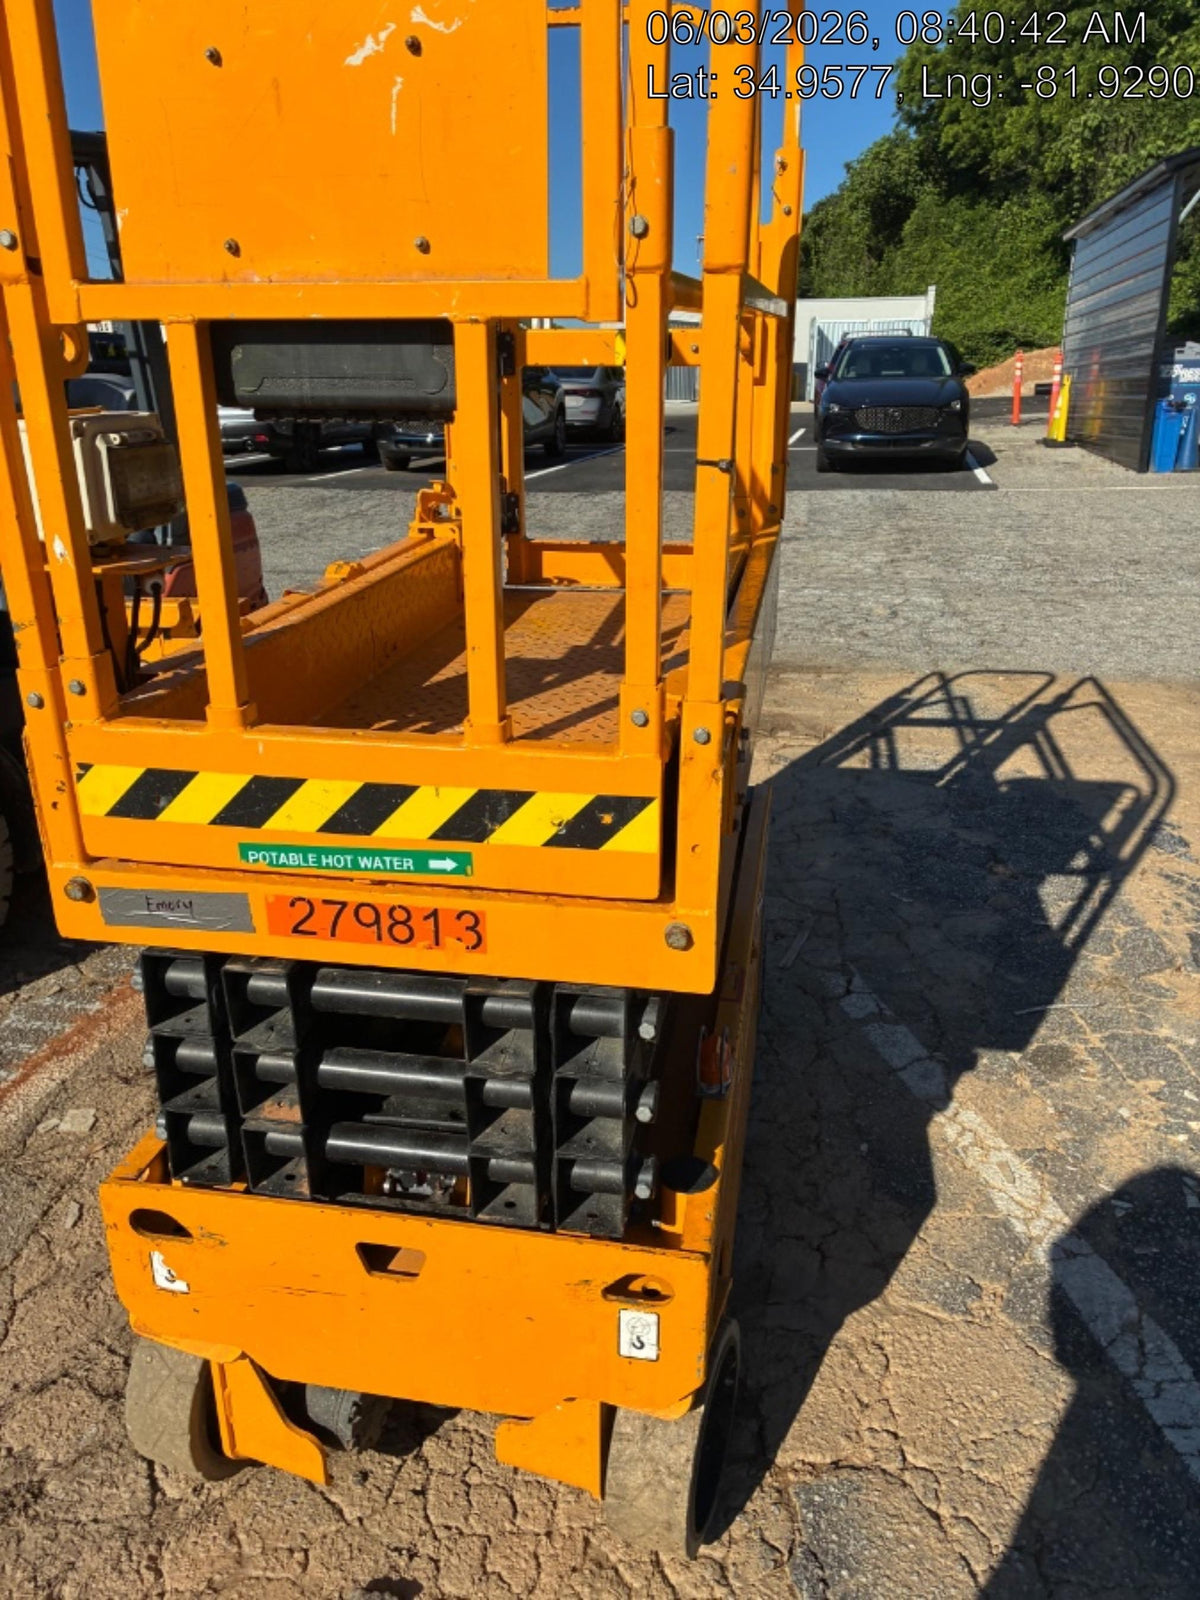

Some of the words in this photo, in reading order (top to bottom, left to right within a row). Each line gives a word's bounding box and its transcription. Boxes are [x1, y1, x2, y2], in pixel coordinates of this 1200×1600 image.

[248, 850, 317, 867] POTABLE
[321, 854, 354, 869] HOT
[358, 856, 415, 871] WATER
[289, 896, 482, 950] 279813
